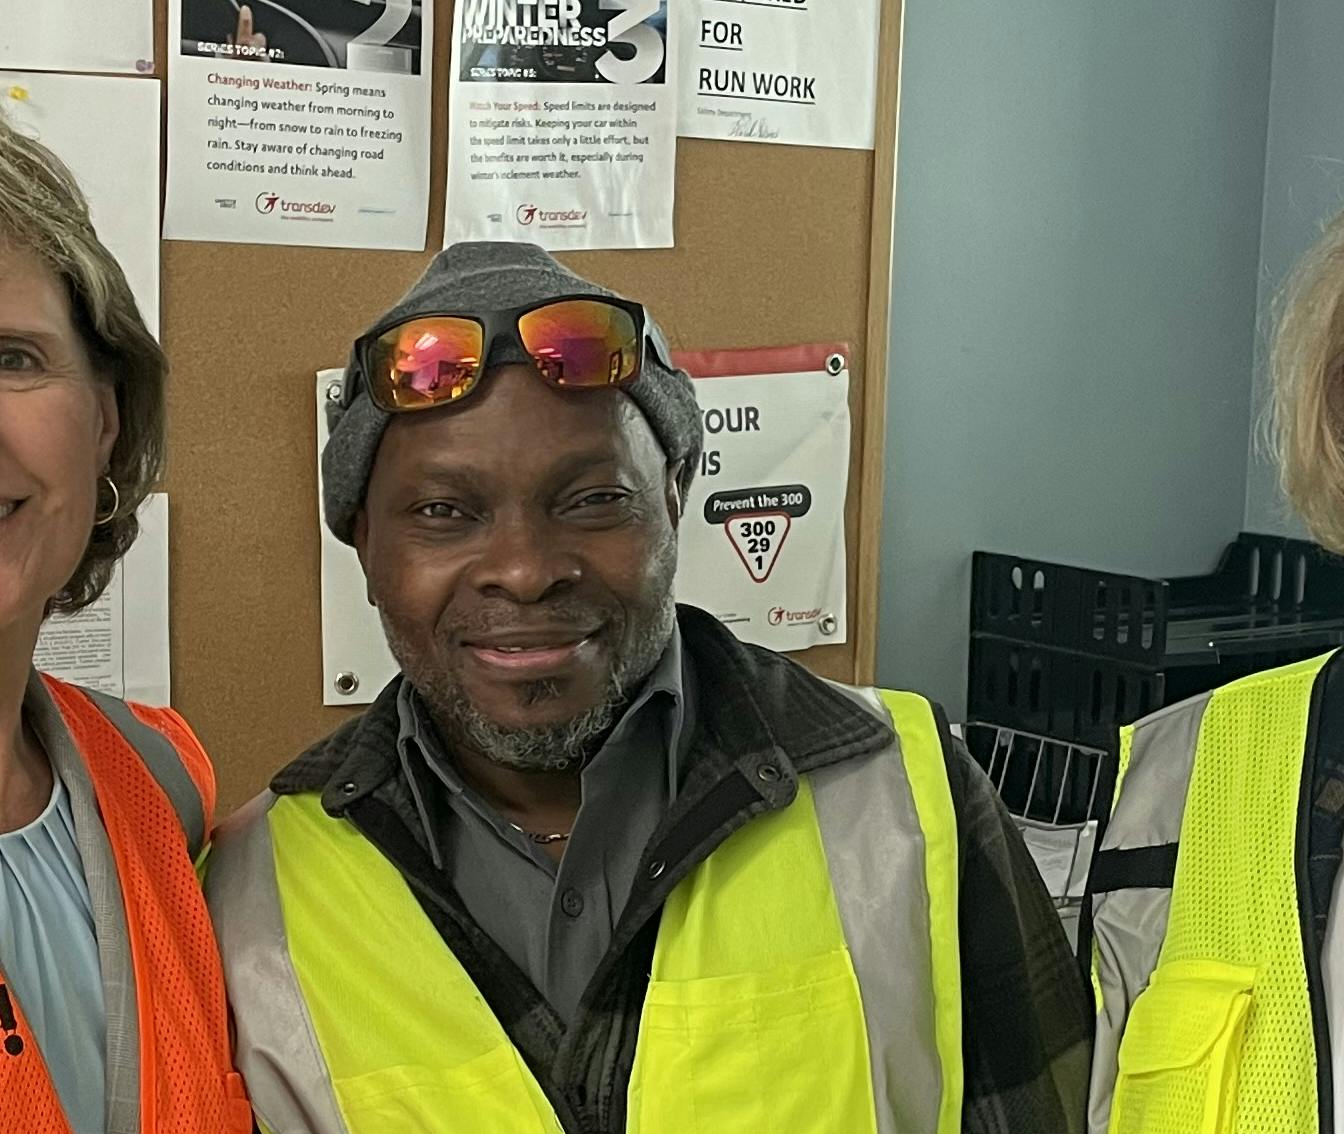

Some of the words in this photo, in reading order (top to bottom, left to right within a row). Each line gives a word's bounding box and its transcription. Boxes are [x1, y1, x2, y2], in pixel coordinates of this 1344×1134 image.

[460, 0, 582, 29] WINTER
[462, 25, 606, 47] PREPAREDNESS
[701, 20, 743, 45] FOR
[207, 73, 260, 89] Changing
[262, 77, 313, 92] Weather:
[315, 81, 350, 97] Spring
[352, 87, 386, 98] means
[699, 68, 746, 92] RUN
[752, 72, 815, 100] WORK
[207, 94, 258, 111] changing
[261, 98, 306, 113] weather
[308, 101, 334, 114] from
[336, 106, 381, 120] morning
[383, 109, 395, 119] to
[544, 102, 570, 113] Speed
[572, 101, 596, 111] limits
[613, 102, 656, 113] designed
[278, 123, 307, 134] snow
[309, 124, 322, 135] to
[324, 126, 344, 136] rain
[346, 126, 357, 137] to
[360, 126, 403, 142] freezing
[535, 119, 570, 130] Keeping
[572, 120, 592, 130] your
[594, 120, 607, 128] car
[609, 118, 638, 128] within
[207, 138, 233, 150] rain.
[234, 140, 258, 153] Stay
[261, 145, 293, 154] aware
[295, 143, 307, 155] of
[309, 144, 357, 160] changing
[360, 149, 384, 160] road
[506, 135, 526, 145] limit
[527, 135, 551, 145] takes
[552, 136, 571, 147] only
[579, 135, 601, 145] little
[633, 136, 649, 145] but
[571, 152, 613, 164] especially
[615, 152, 644, 163] during
[206, 160, 265, 174] conditions
[267, 163, 288, 175] and
[290, 164, 319, 177] think
[321, 166, 357, 179] ahead.
[281, 199, 336, 214] transdev
[702, 406, 761, 434] OUR
[713, 496, 756, 512] Prevent
[757, 494, 779, 508] the
[781, 492, 803, 506] 300
[740, 520, 776, 538] 300
[747, 537, 771, 554] 29
[754, 555, 763, 570] 1
